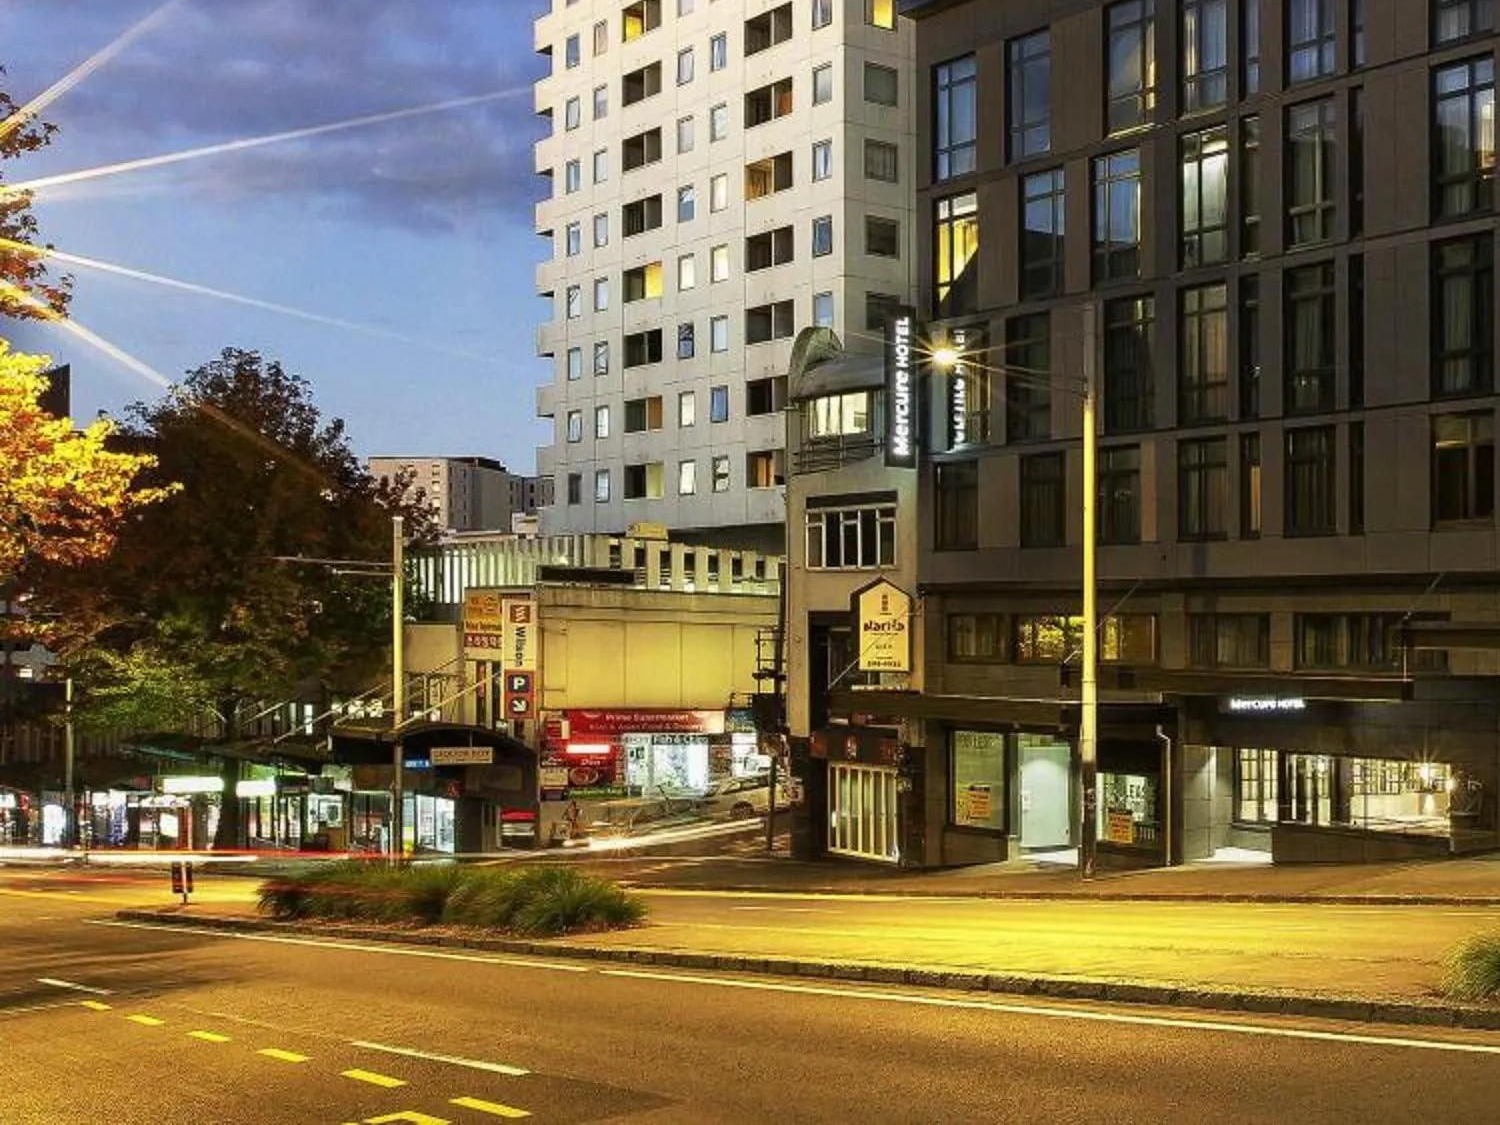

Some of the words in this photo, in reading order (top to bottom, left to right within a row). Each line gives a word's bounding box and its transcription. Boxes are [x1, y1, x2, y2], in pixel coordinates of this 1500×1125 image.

[895, 316, 910, 368] HOTEL
[892, 371, 910, 456] Mercure
[513, 676, 526, 690] P
